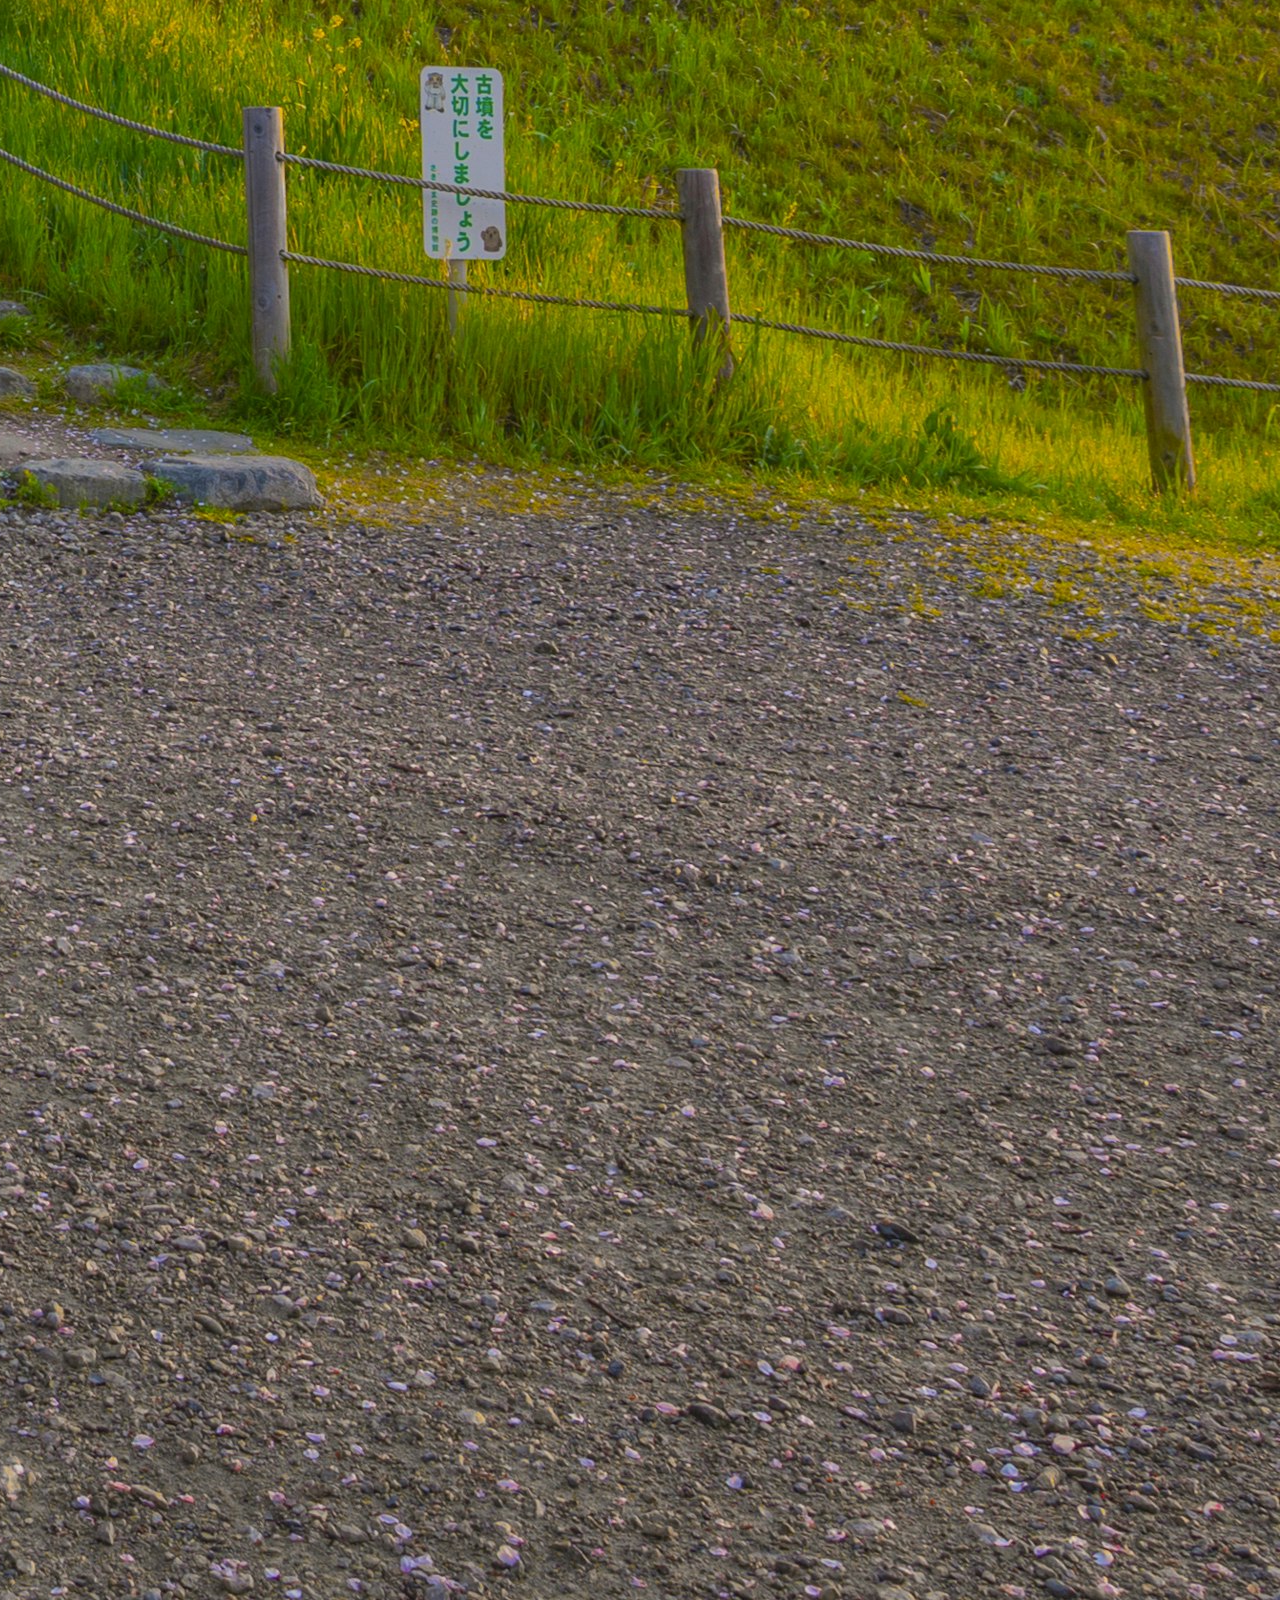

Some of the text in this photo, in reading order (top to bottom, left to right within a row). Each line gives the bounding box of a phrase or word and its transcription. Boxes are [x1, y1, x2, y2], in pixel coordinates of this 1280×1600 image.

[450, 73, 473, 252] 大切にしましょう
[475, 74, 494, 140] 古墳を
